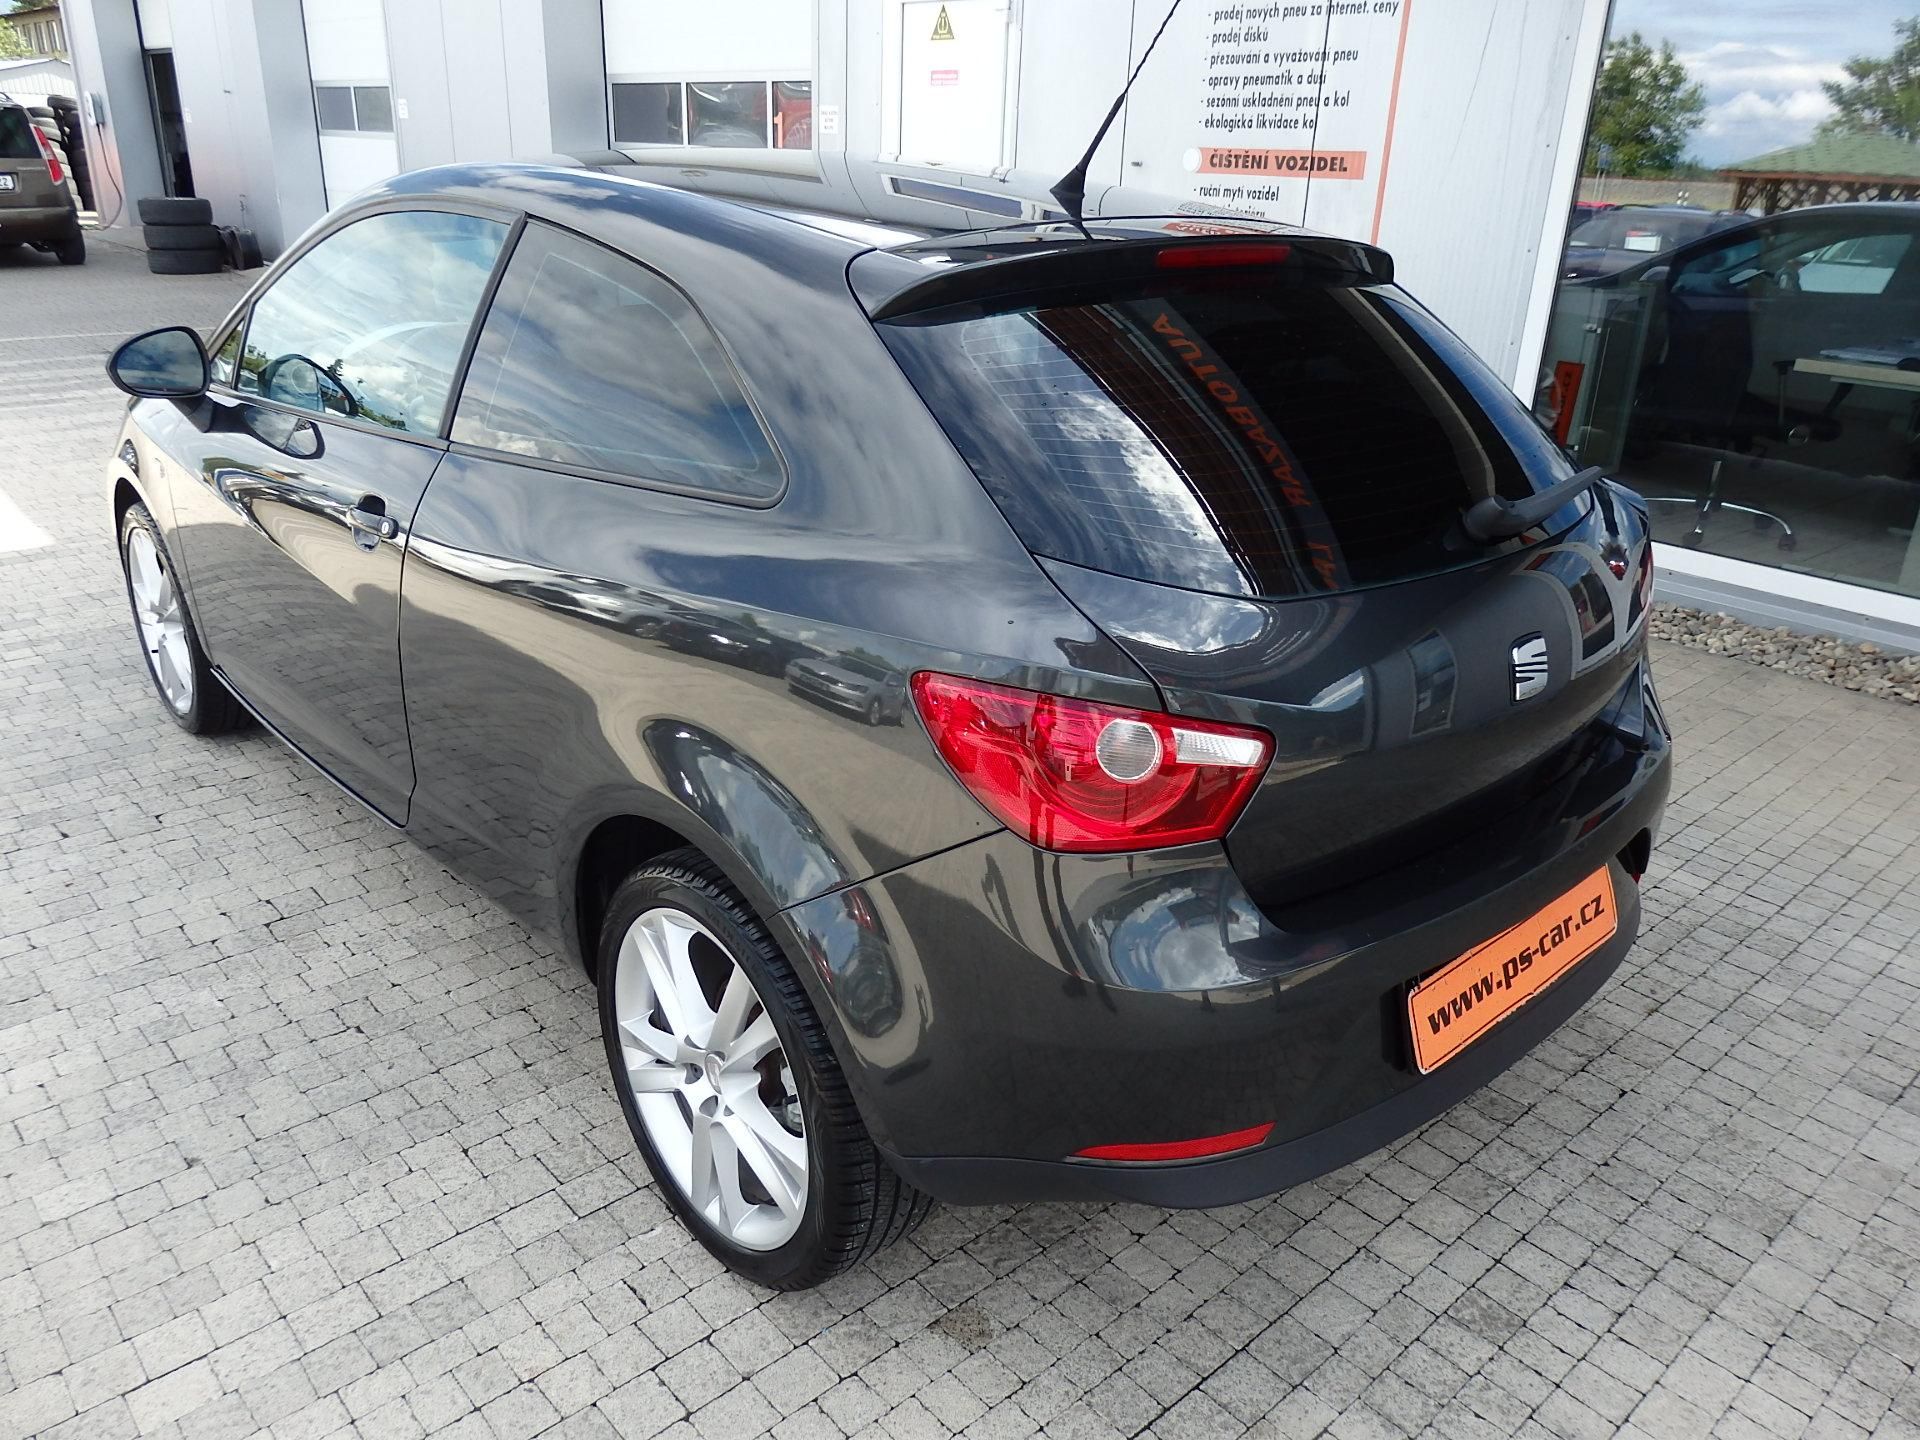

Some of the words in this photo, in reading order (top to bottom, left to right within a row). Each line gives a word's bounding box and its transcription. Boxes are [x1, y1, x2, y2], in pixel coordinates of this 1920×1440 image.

[1213, 4, 1244, 25] prodej
[1245, 2, 1280, 23] nových
[1282, 5, 1308, 21] pneu
[1310, 4, 1322, 16] za
[1373, 1, 1399, 17] ceny
[1211, 27, 1241, 48] prodej
[1263, 53, 1270, 64] a
[1332, 50, 1359, 66] pneu
[1208, 76, 1240, 91] opravy
[1242, 69, 1293, 90] pneumatik
[1296, 74, 1303, 85] a
[1295, 96, 1320, 111] pneu
[1323, 97, 1330, 107] a
[1333, 90, 1350, 107] kol
[1204, 113, 1253, 133] ekologická
[1256, 113, 1299, 129] likvidace
[1209, 148, 1269, 170] ČIŠTĚNÍ
[1274, 155, 1348, 172] VOZIDEL
[1246, 185, 1280, 201] vozidel
[1426, 894, 1605, 1036] www.ps-car.cz
